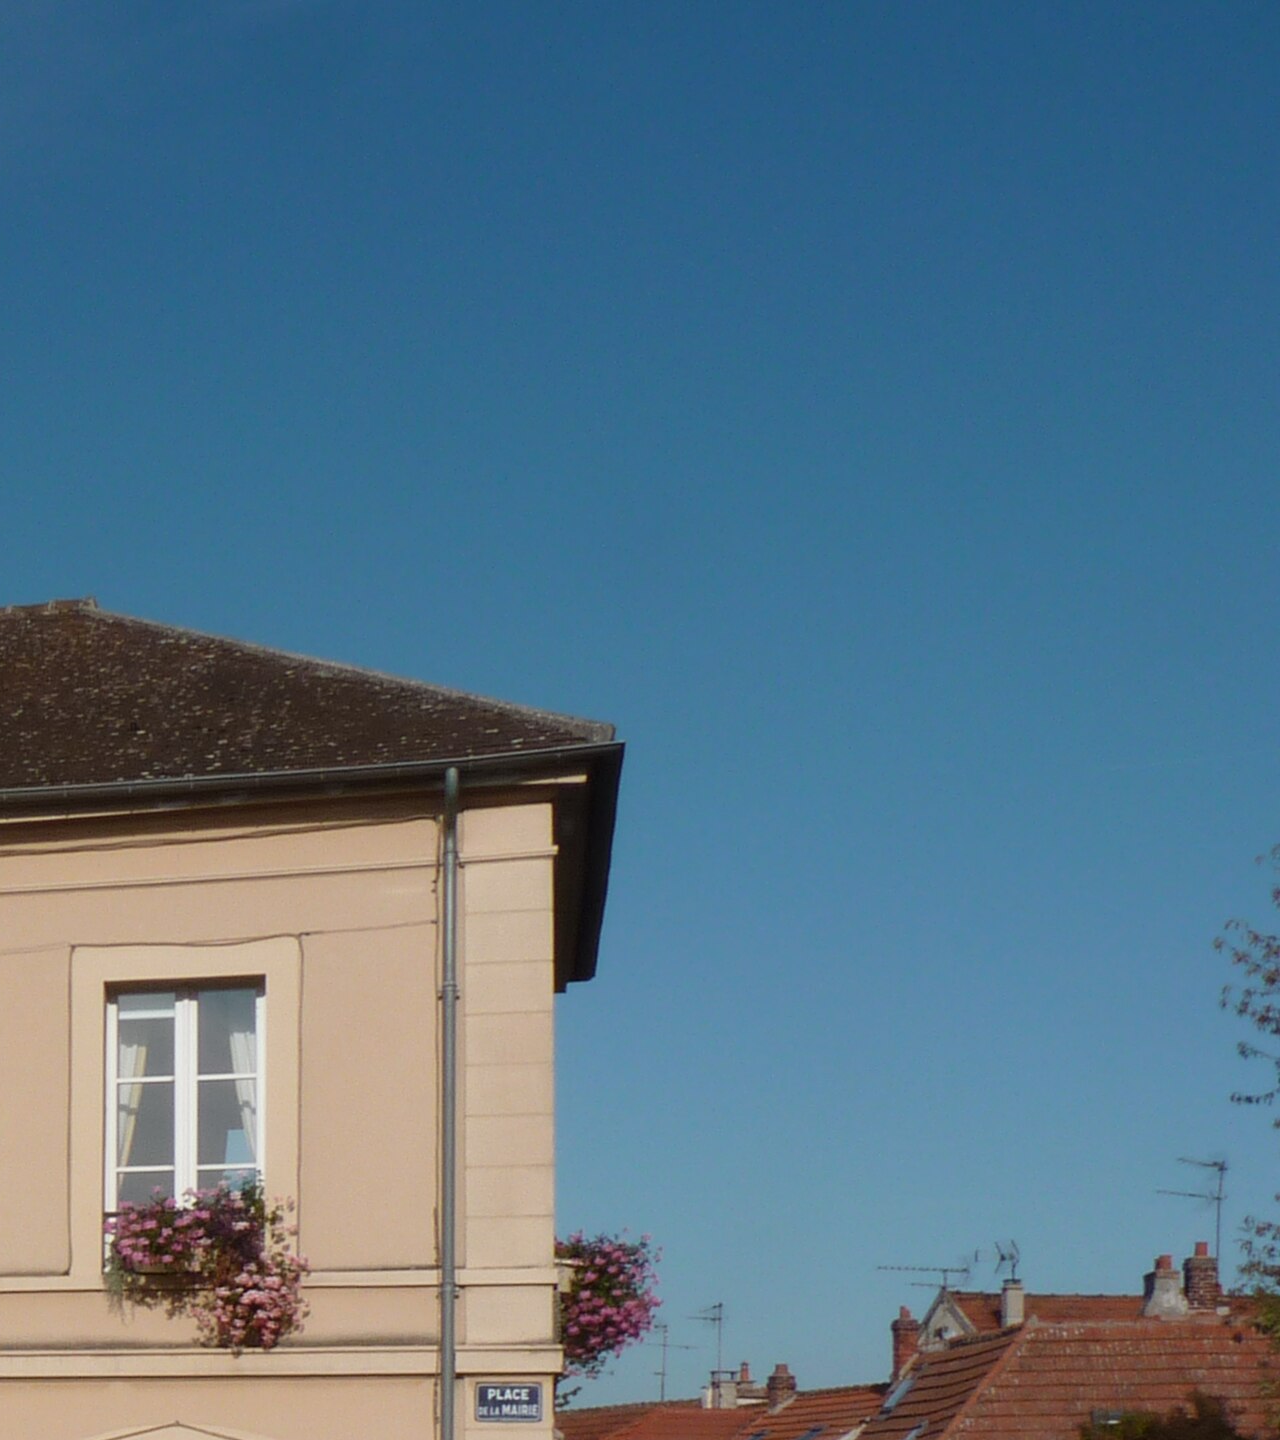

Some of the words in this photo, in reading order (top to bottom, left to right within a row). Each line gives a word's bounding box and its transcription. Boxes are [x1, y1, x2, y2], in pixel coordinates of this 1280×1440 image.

[487, 1388, 530, 1401] PLACE
[478, 1406, 488, 1416] DE
[490, 1406, 500, 1416] LA
[501, 1404, 538, 1416] MAIRIE
